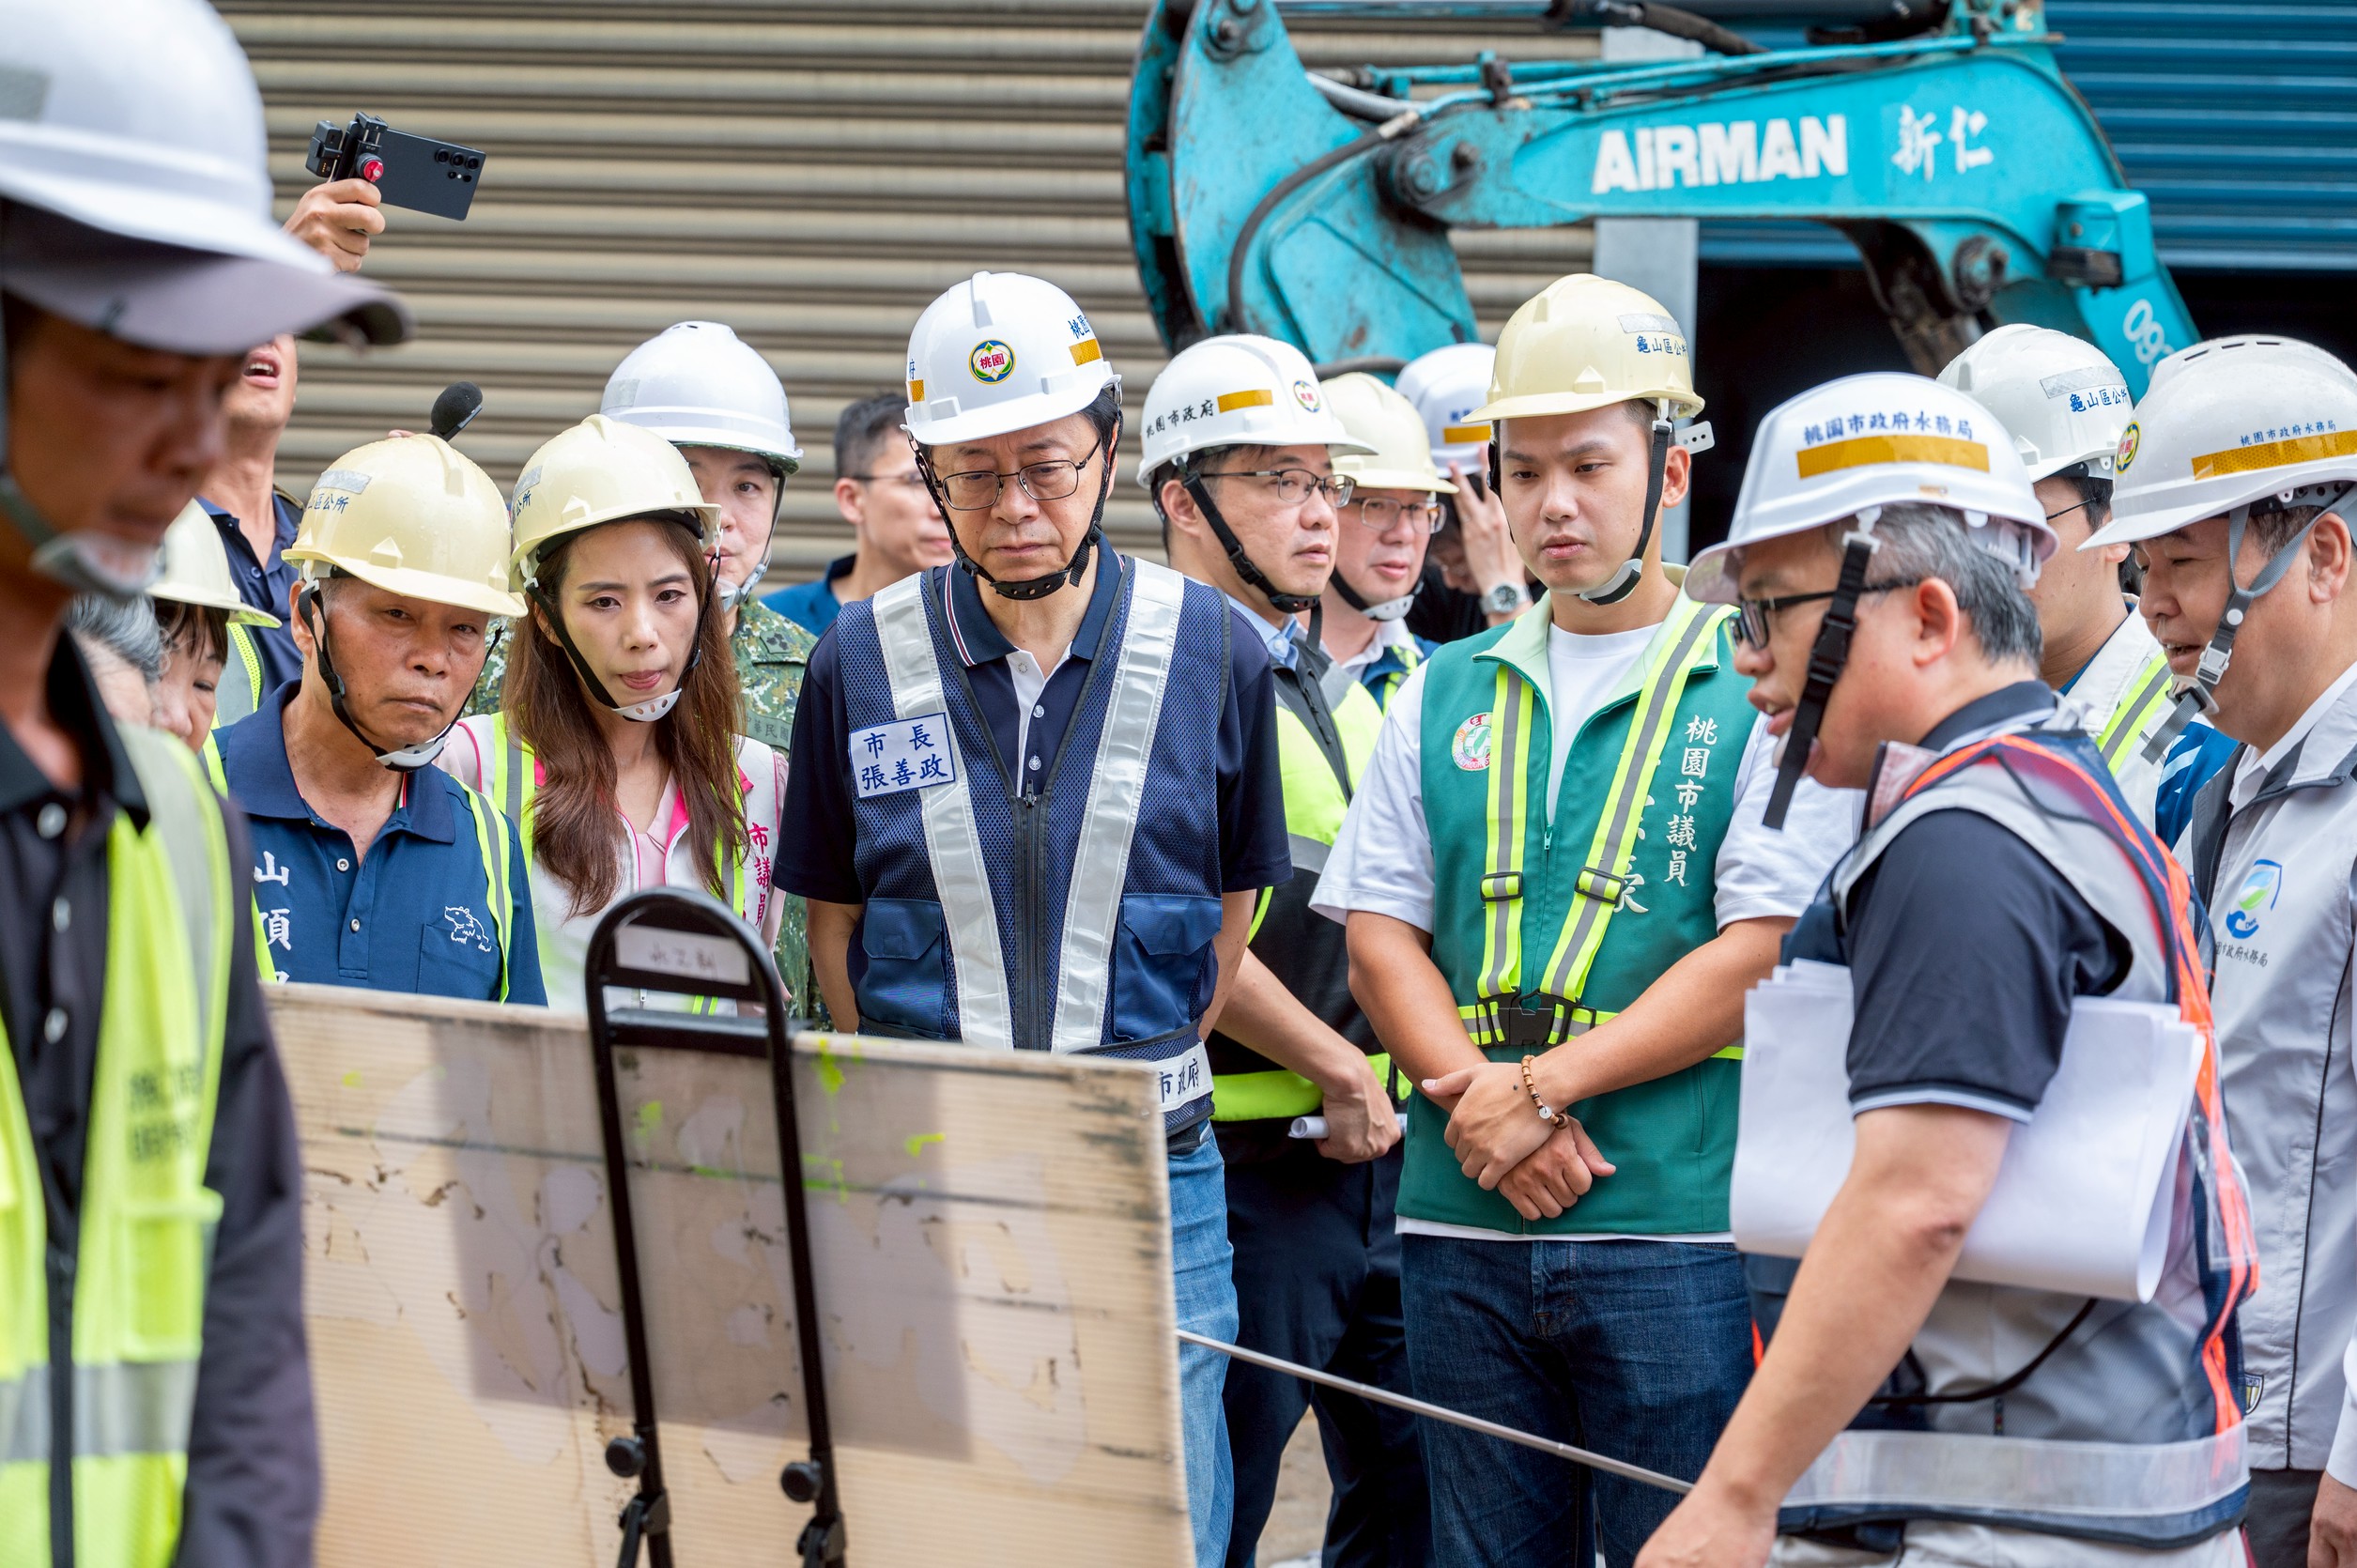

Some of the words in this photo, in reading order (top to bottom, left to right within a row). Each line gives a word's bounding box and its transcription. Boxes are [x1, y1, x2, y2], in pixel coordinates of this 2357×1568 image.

[1592, 114, 1848, 194] AIRMAN
[1891, 104, 1995, 183] 新仁
[979, 353, 1006, 370] 桃園
[1146, 400, 1214, 438] 桃園市政府
[1804, 410, 1974, 445] 桃園市政府水務局
[2240, 420, 2336, 447] 桃園市政府水務局
[863, 724, 935, 759] 市長
[862, 753, 948, 791] 張善政
[1663, 715, 1718, 887] 桃園市議員
[747, 822, 771, 930] 市議員
[253, 850, 292, 985] 山頂
